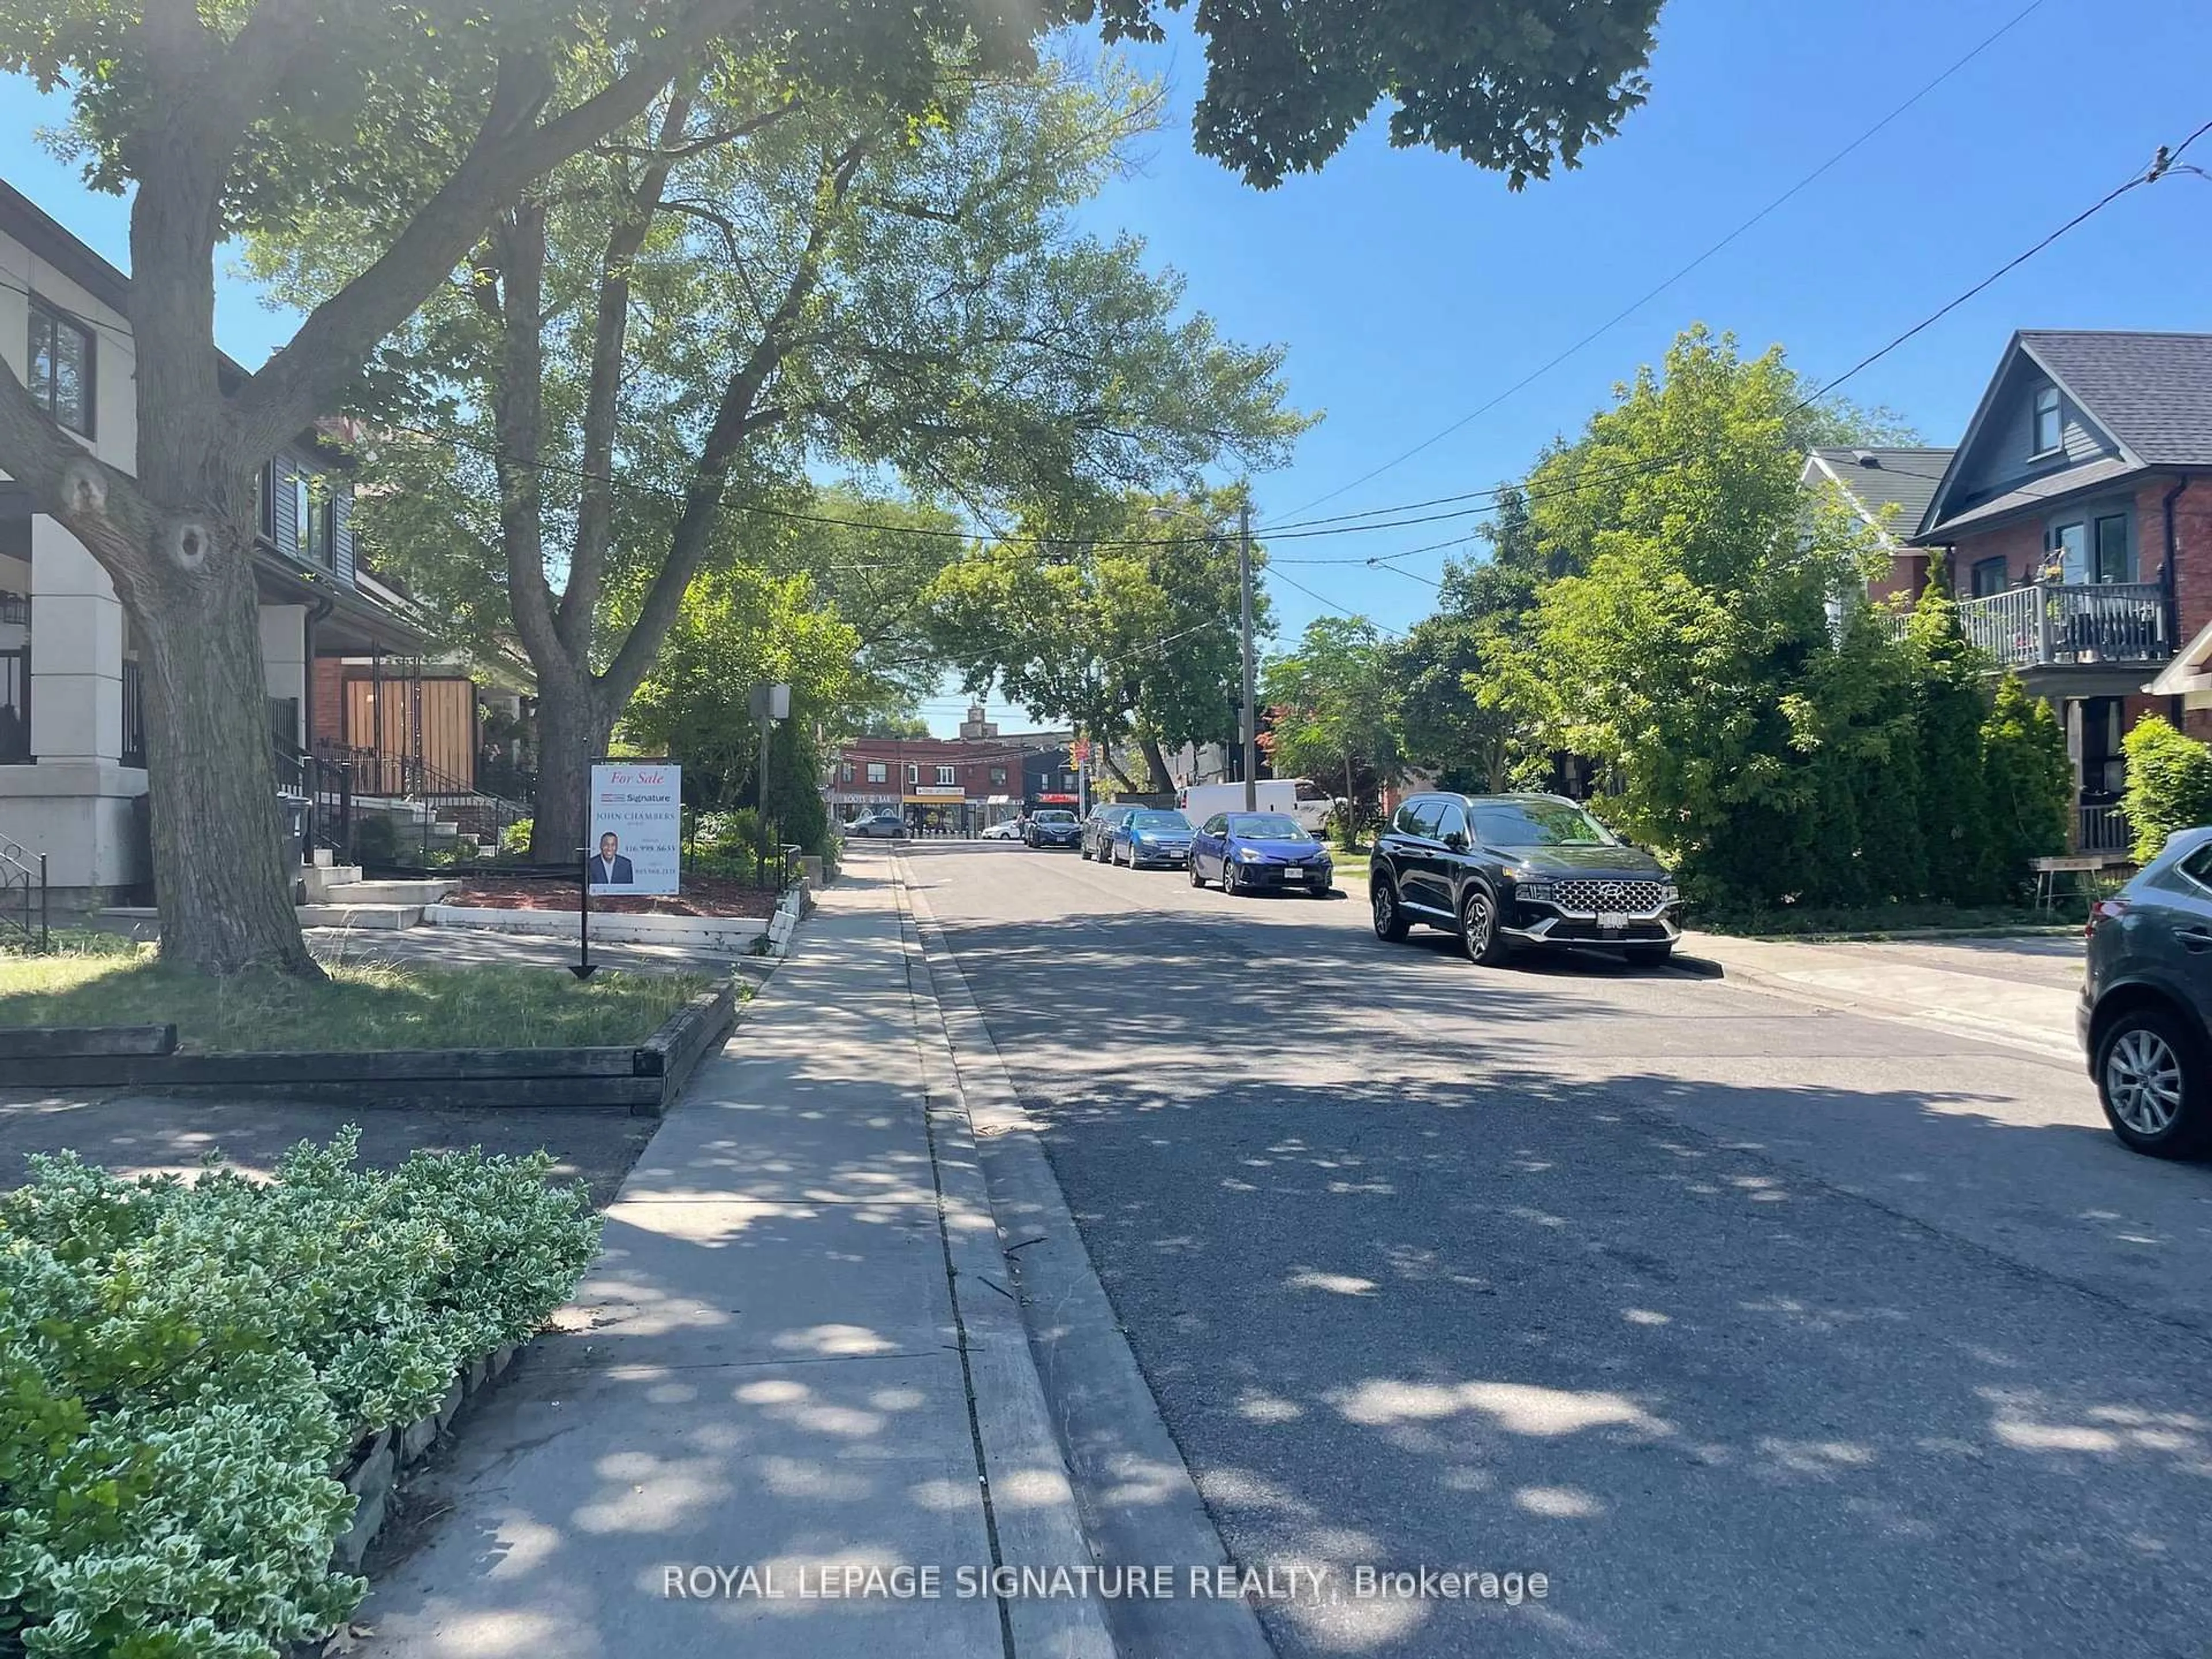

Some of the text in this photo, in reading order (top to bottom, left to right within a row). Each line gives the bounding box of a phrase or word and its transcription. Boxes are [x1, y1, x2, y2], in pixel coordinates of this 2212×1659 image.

[611, 771, 664, 784] For Sale
[627, 794, 671, 802] Signature
[597, 812, 675, 820] JOHN CHAMBERS
